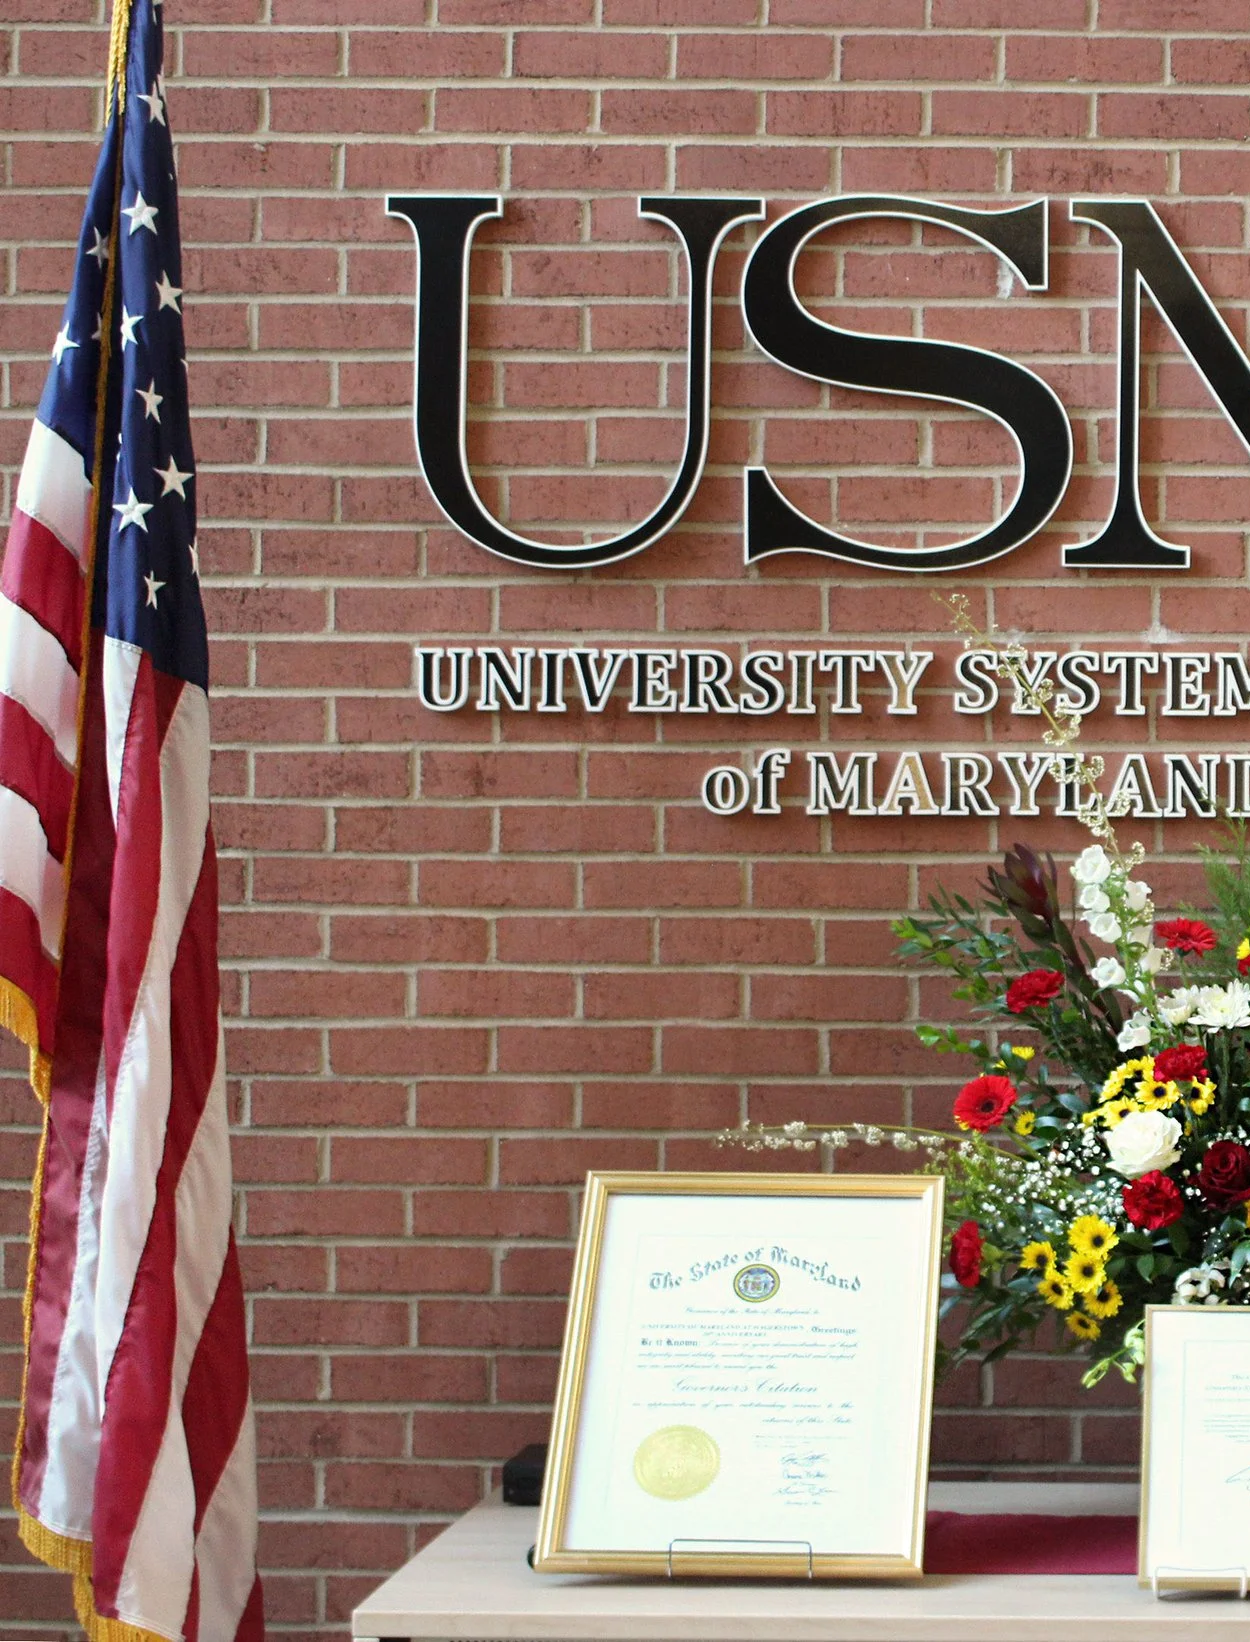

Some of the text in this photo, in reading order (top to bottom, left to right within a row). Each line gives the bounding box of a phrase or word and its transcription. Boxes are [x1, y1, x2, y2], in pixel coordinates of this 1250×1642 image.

[416, 646, 932, 716] UNIVERSITY
[701, 748, 789, 816] of
[649, 1245, 861, 1292] The State of Maryland
